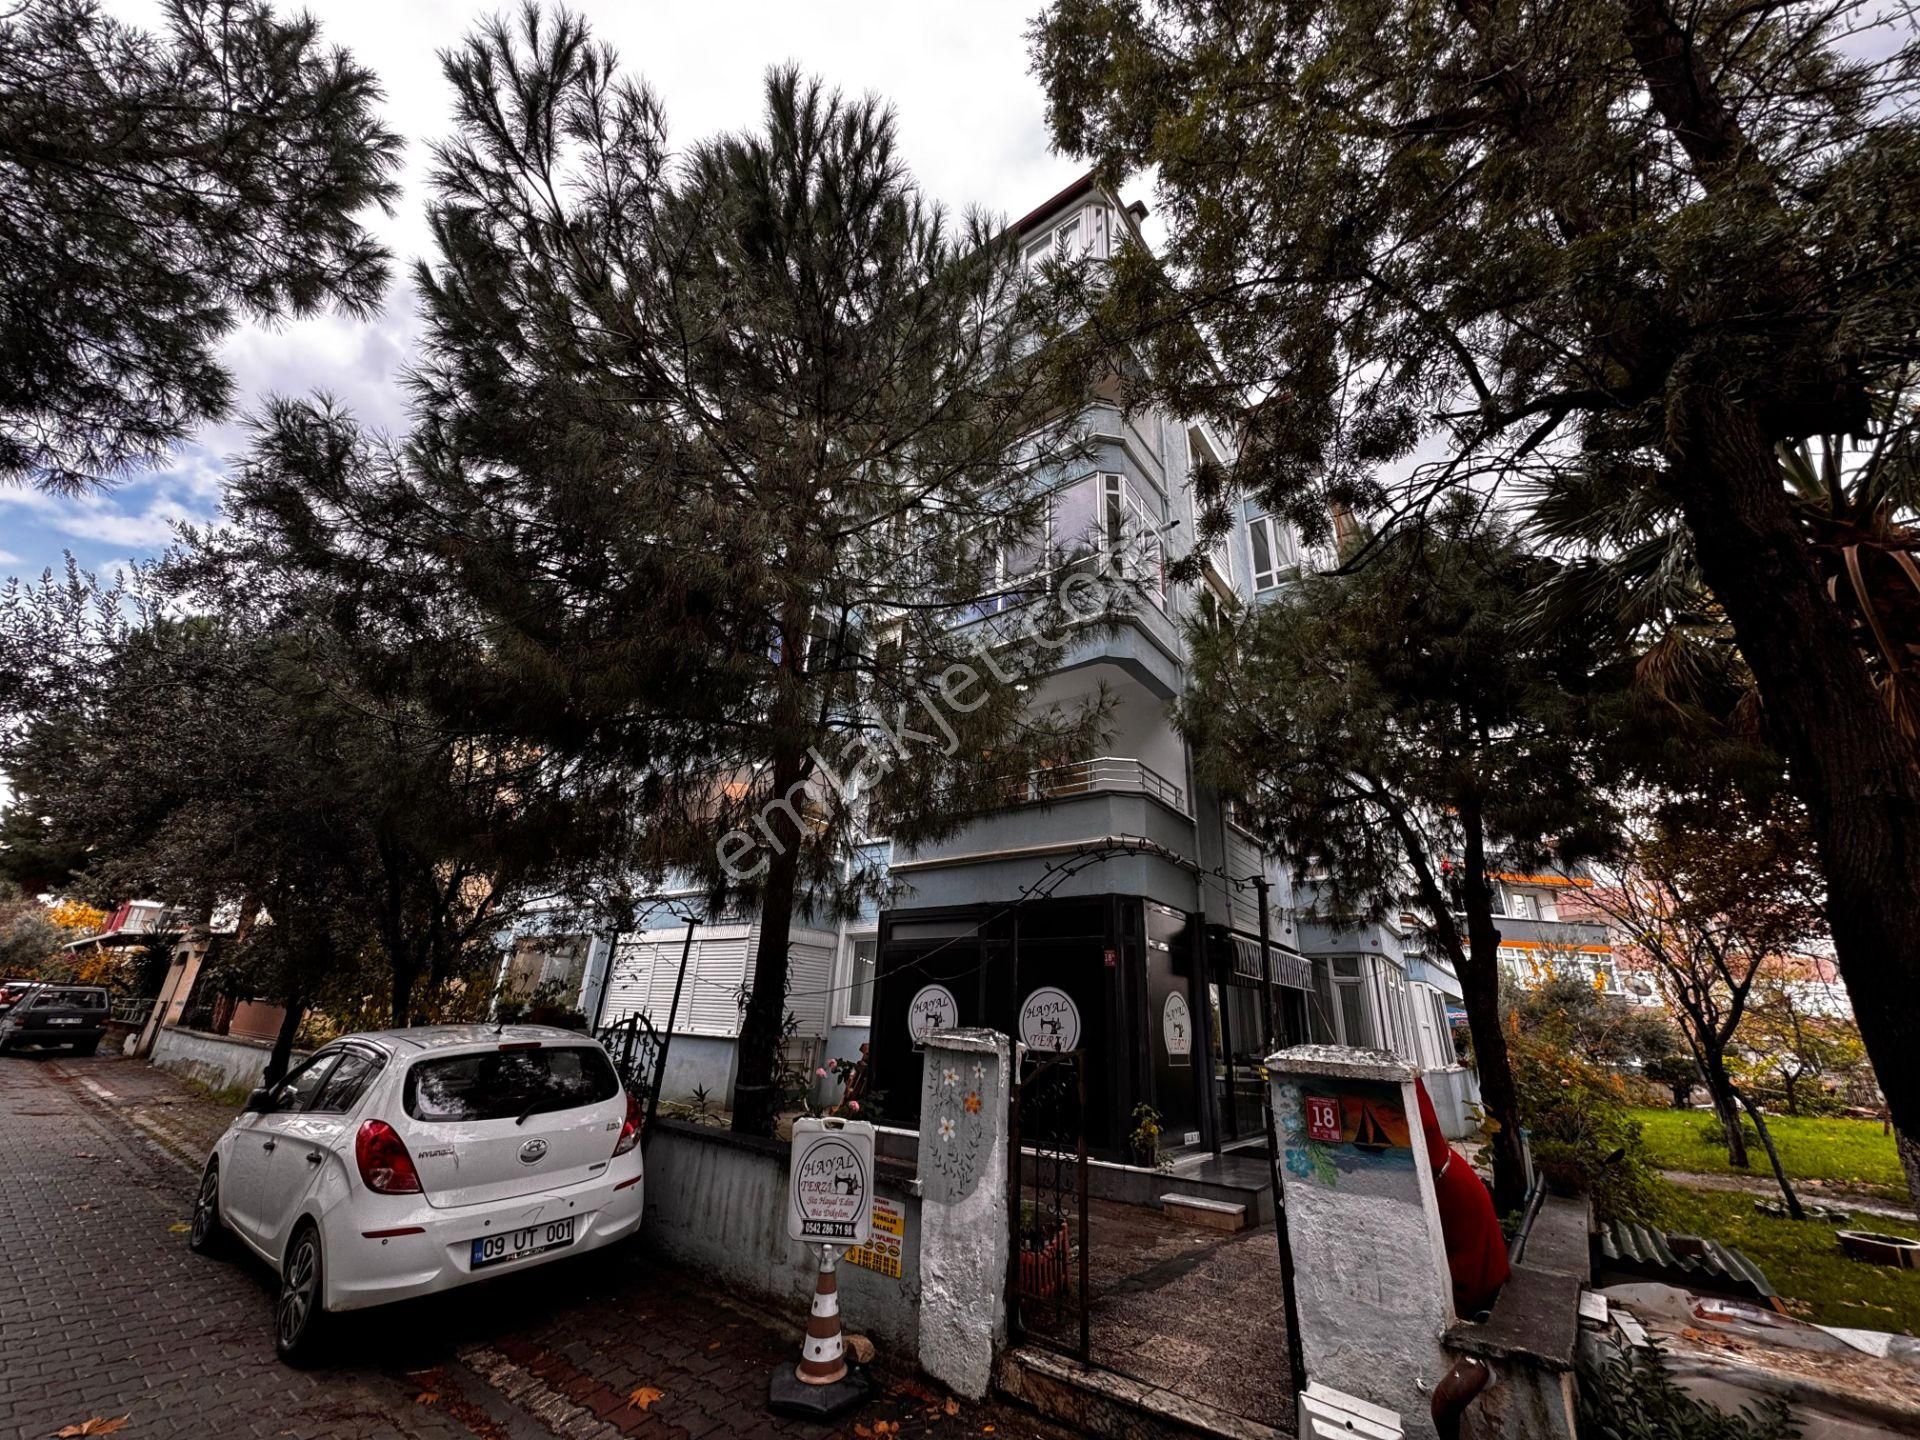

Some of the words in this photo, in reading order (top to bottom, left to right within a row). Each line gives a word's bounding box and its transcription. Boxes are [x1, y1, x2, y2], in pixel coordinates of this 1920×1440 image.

[914, 997, 949, 1014] HAYAL
[1026, 1001, 1068, 1018] HAYAL
[1312, 1106, 1335, 1128] 18
[804, 1155, 854, 1177] HAYAL
[801, 1180, 833, 1194] TERZİ
[818, 1197, 838, 1208] Hayal
[805, 1222, 821, 1233] 0542
[822, 1223, 834, 1234] 286
[835, 1224, 843, 1235] 71
[484, 1236, 505, 1258] 09
[514, 1228, 538, 1250] UT
[547, 1220, 571, 1242] 001
